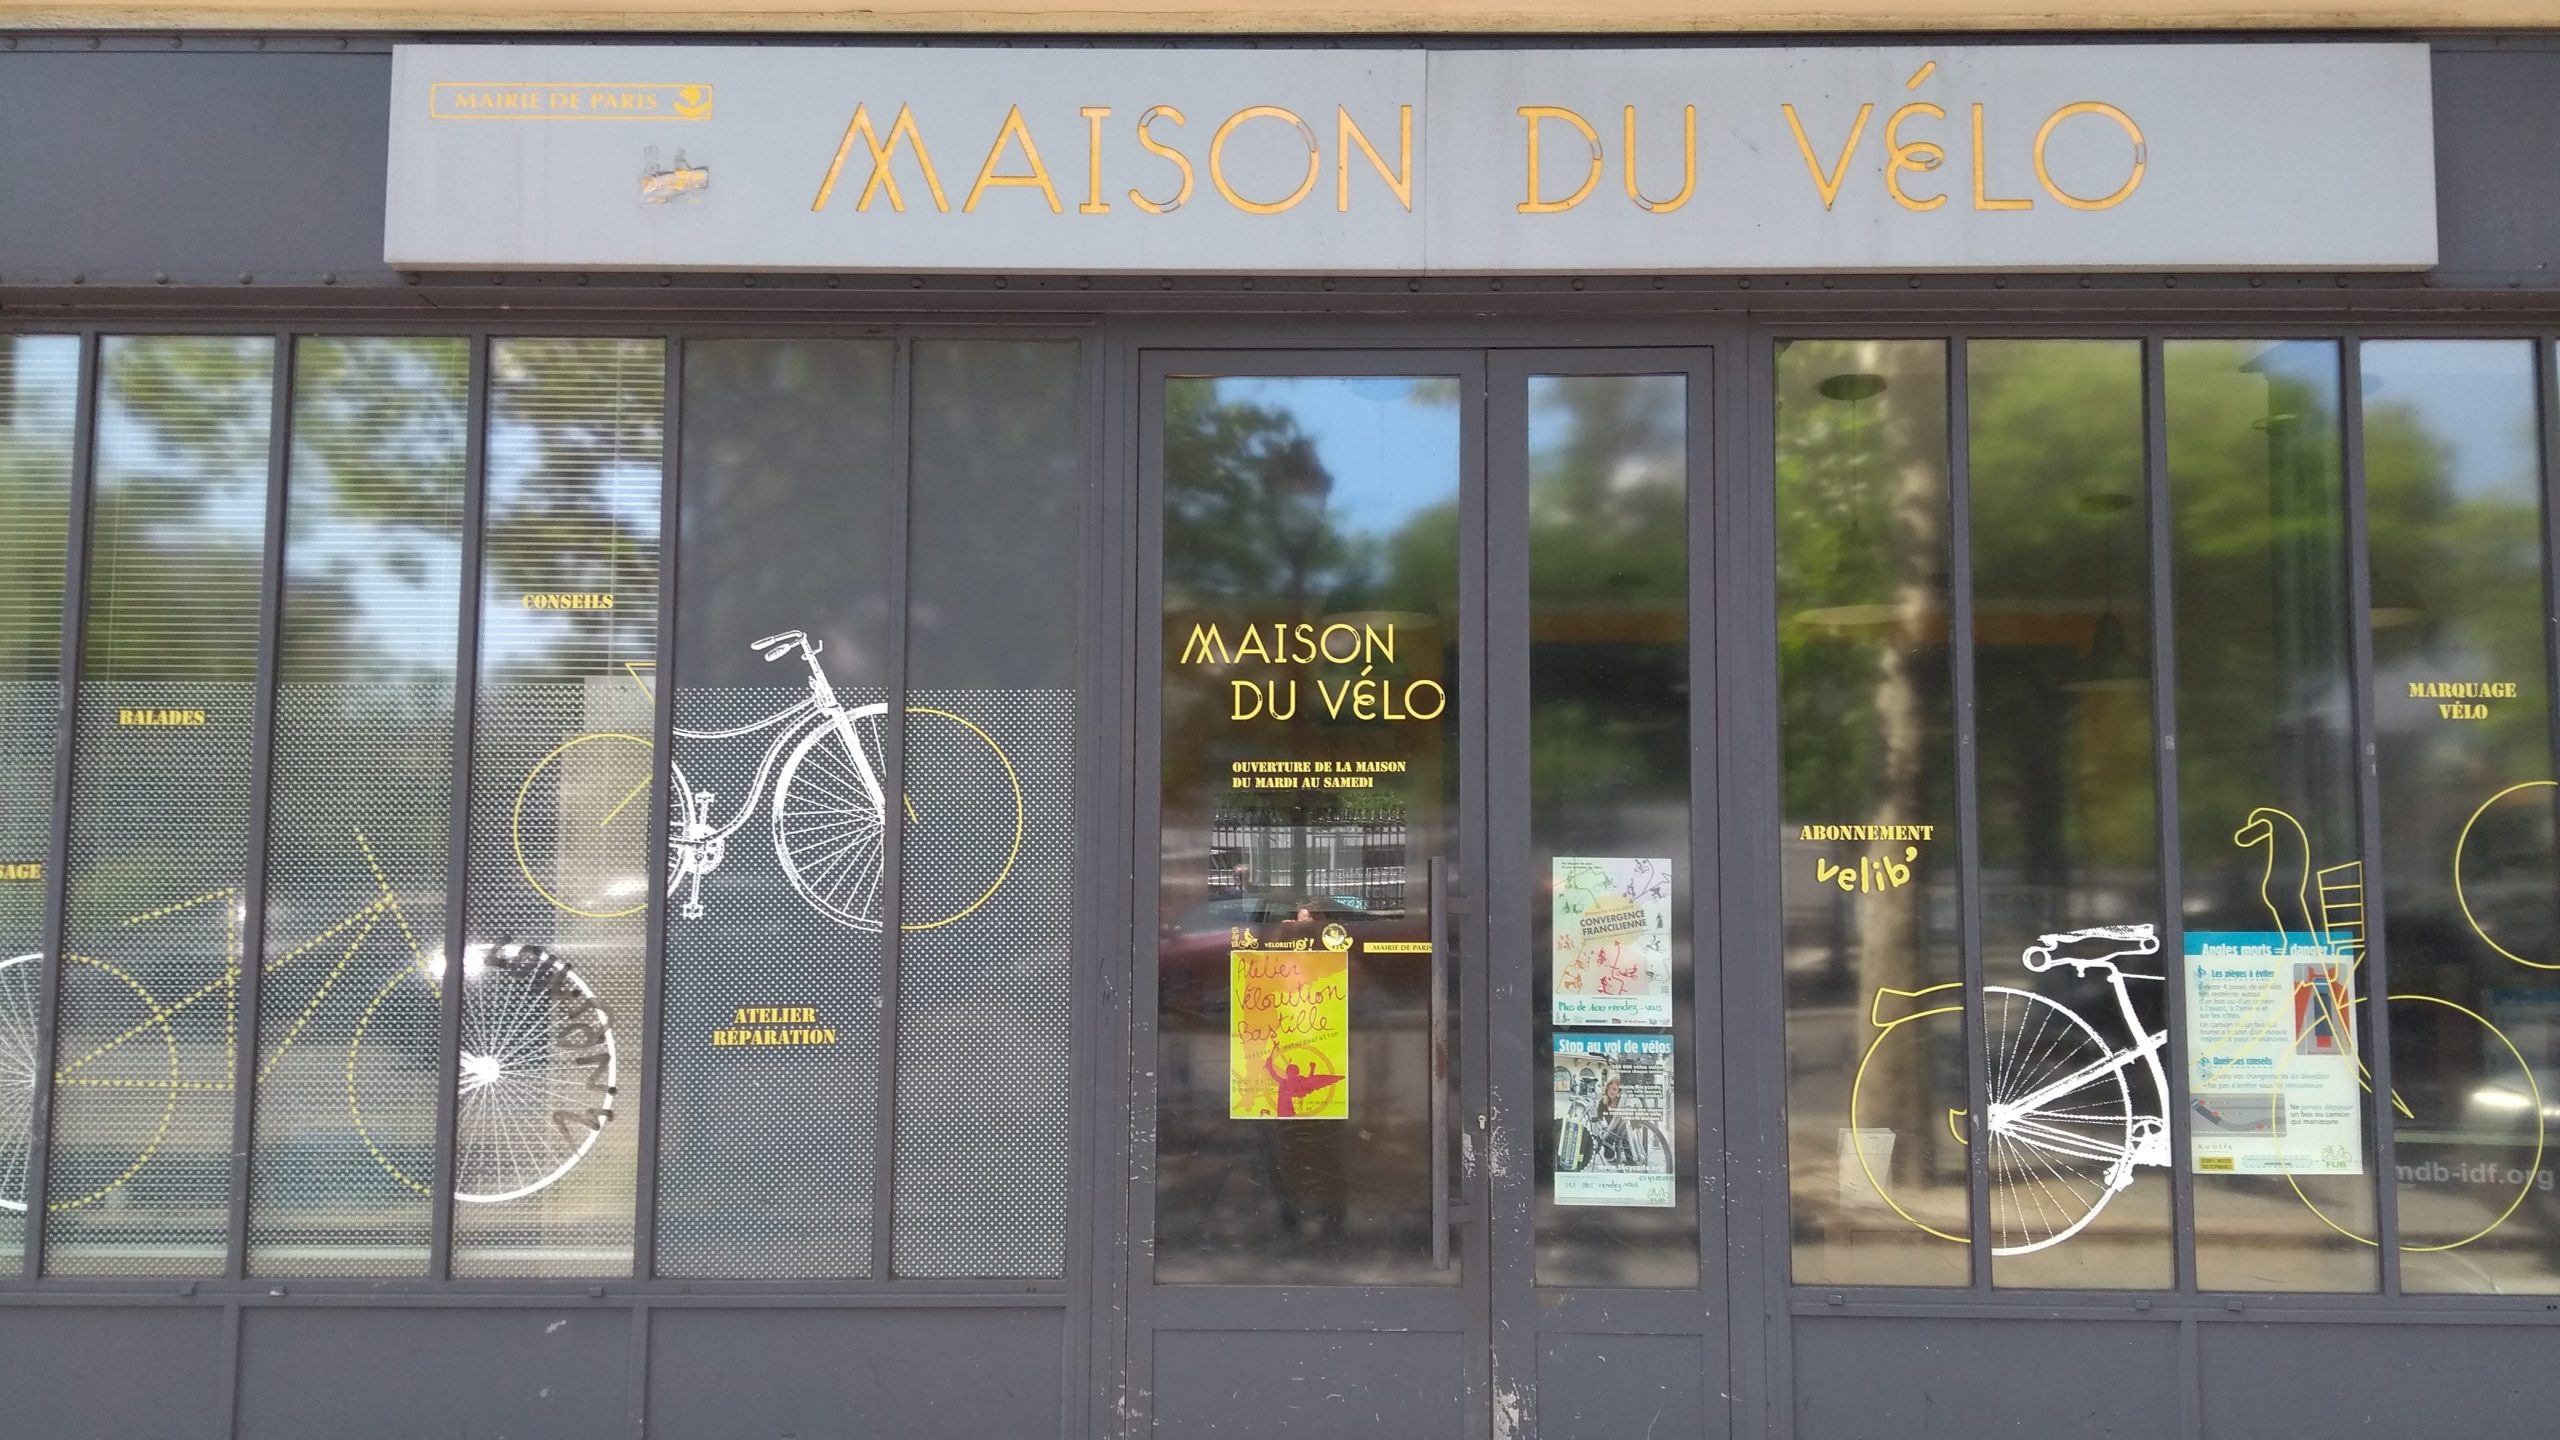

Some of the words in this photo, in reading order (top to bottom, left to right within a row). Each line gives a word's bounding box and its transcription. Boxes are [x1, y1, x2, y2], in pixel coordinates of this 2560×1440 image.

[455, 92, 540, 109] MAIRIE
[549, 92, 580, 109] DE
[590, 92, 658, 110] PARIS
[811, 101, 1413, 216] MAISON
[1517, 104, 1697, 215] DU
[1781, 60, 2147, 213] VÉLO
[522, 593, 614, 610] CONSEILS
[1180, 623, 1394, 664] MAISON
[1231, 680, 1297, 721] DU
[1317, 665, 1446, 720] VÉLO
[2408, 682, 2517, 698] MARQUAGE
[118, 708, 206, 726] BALADES
[2438, 700, 2489, 719] VÉLO
[1232, 761, 1311, 773] OUVERTURE
[1314, 761, 1332, 773] DE
[1336, 761, 1352, 773] LA
[1355, 761, 1407, 773] MAISON
[1232, 777, 1251, 788] DU
[1255, 777, 1299, 788] MARDI
[1301, 777, 1320, 788] AU
[1323, 777, 1374, 788] SAMEDI
[1799, 825, 1934, 841] ABONNEMENT
[1580, 909, 1645, 927] CONVERGENCE
[1582, 918, 1648, 935] FRANCILIENNE
[2202, 943, 2238, 956] Angles
[2240, 944, 2271, 956] morts
[1237, 956, 1302, 980] Atelier
[2225, 970, 2247, 979] pièges
[1577, 1000, 1586, 1012] de
[734, 1007, 816, 1024] ATELIER
[712, 1026, 837, 1047] RÉPARATION
[1559, 1038, 1584, 1053] Stop
[1587, 1041, 1601, 1052] au
[1604, 1040, 1622, 1053] vol
[1624, 1041, 1638, 1053] de
[1641, 1039, 1671, 1054] vélos
